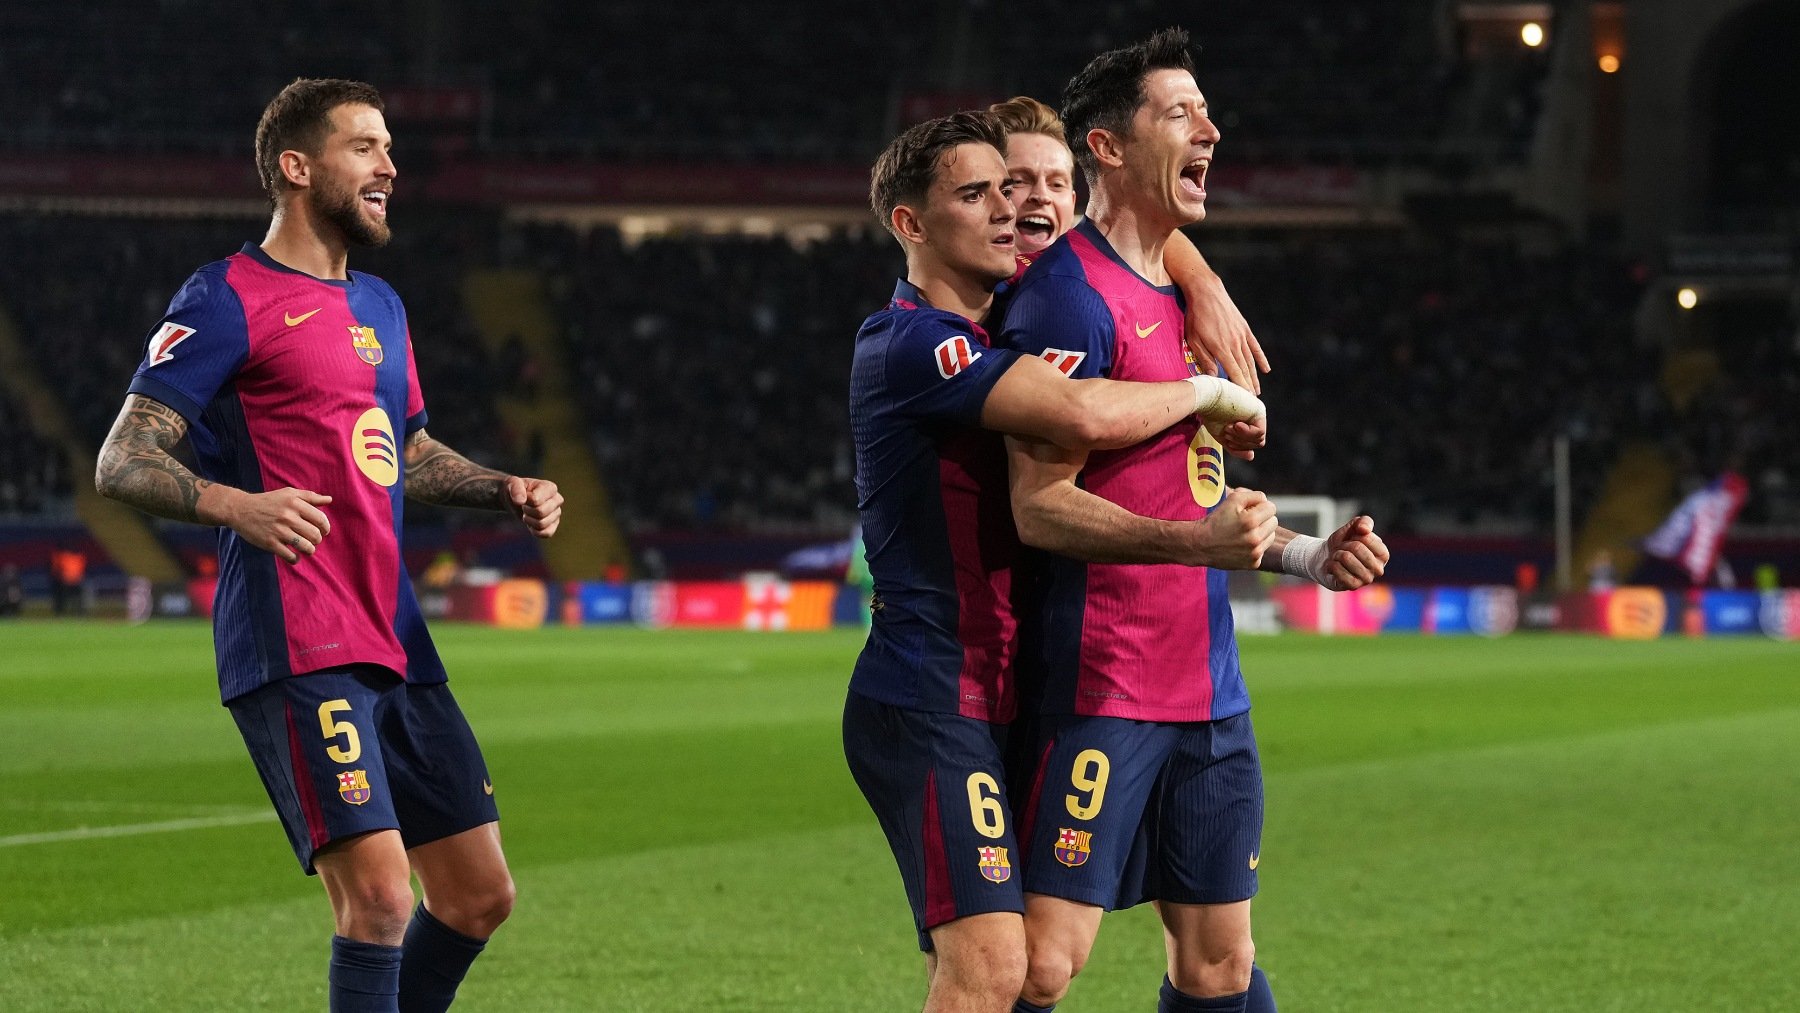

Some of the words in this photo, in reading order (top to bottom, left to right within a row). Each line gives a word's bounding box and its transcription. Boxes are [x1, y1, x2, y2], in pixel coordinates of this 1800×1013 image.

[318, 699, 361, 764] 5
[966, 772, 1005, 838] 6
[1065, 749, 1110, 821] 9
